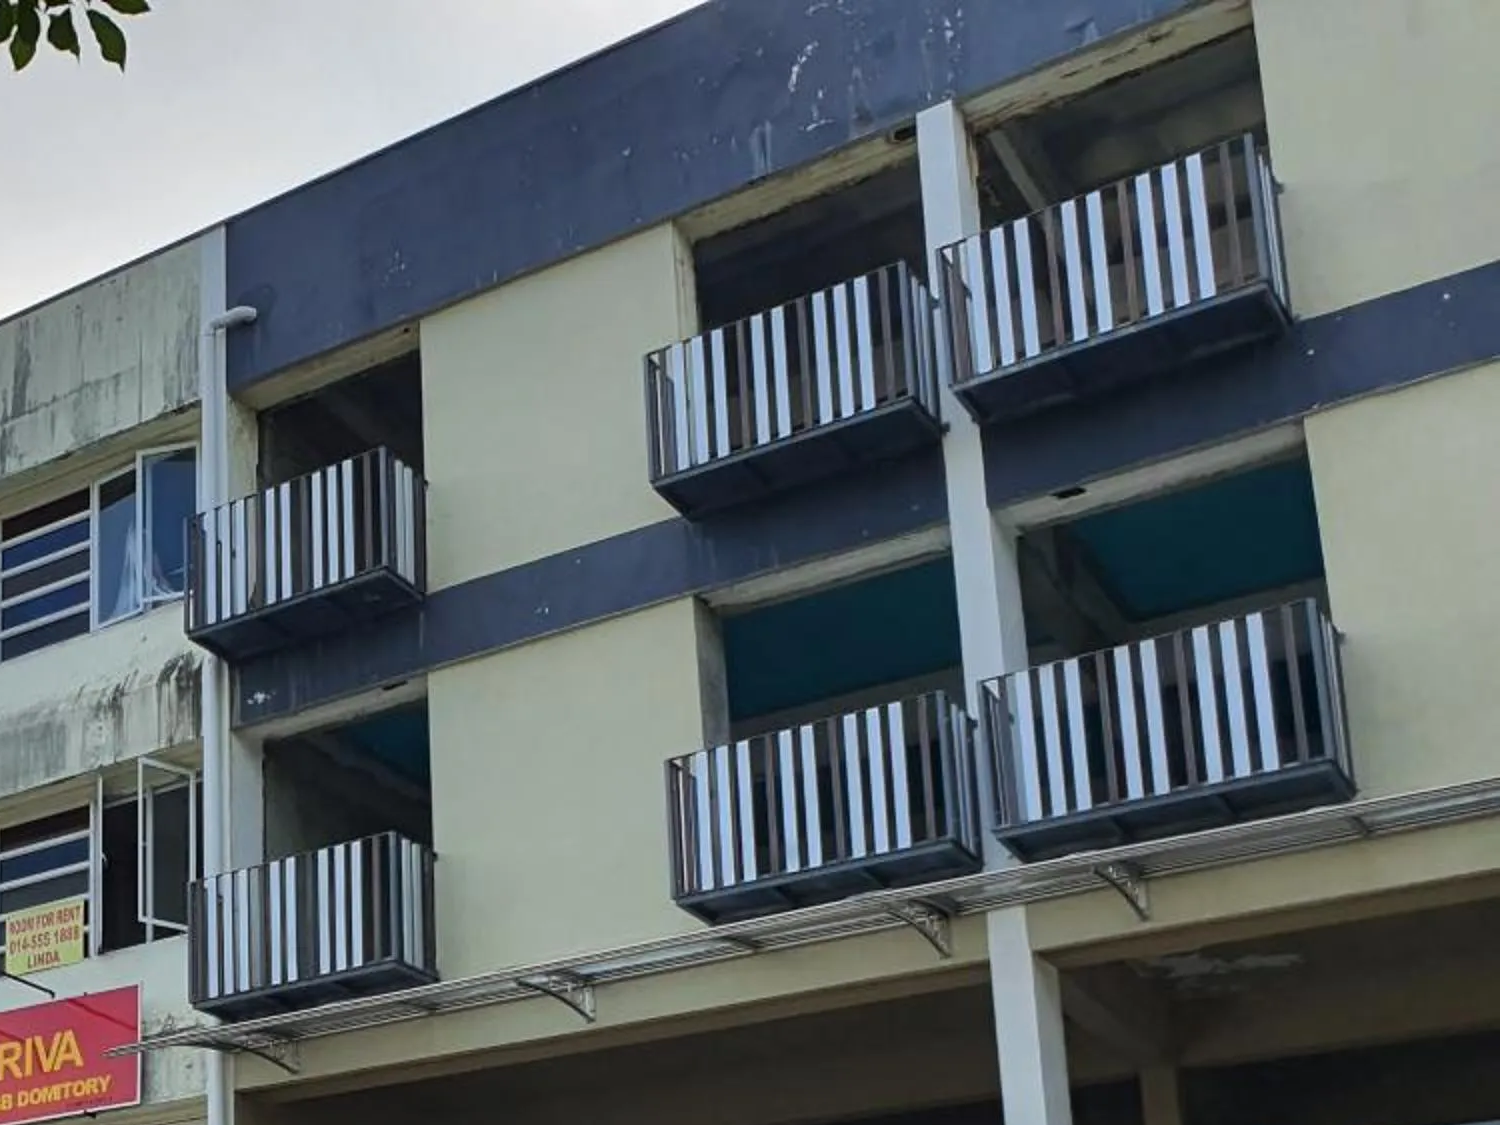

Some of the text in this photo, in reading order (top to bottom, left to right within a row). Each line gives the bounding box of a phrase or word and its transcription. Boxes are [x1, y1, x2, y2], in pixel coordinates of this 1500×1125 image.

[56, 905, 81, 925] RENT
[27, 950, 61, 969] LINDA
[17, 1074, 113, 1109] DOMITORY
